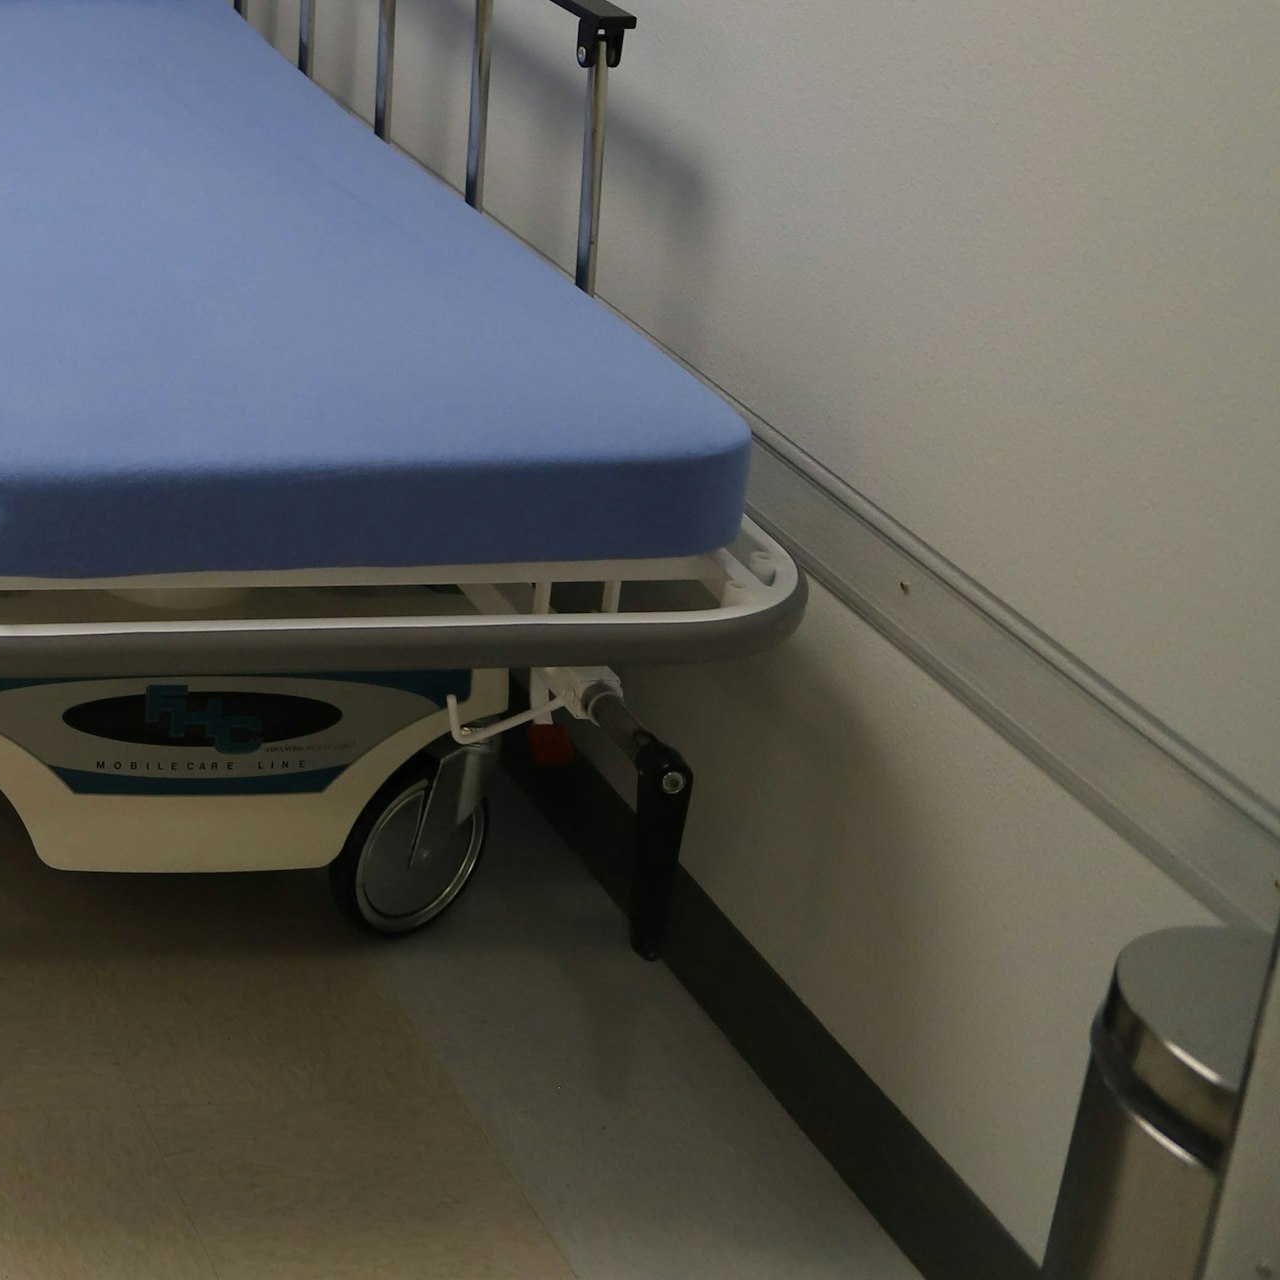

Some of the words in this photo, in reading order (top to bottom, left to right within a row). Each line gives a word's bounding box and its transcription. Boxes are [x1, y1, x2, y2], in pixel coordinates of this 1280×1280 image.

[145, 684, 263, 754] FHC
[96, 761, 234, 771] MOBILECARE
[258, 759, 306, 769] LINE
